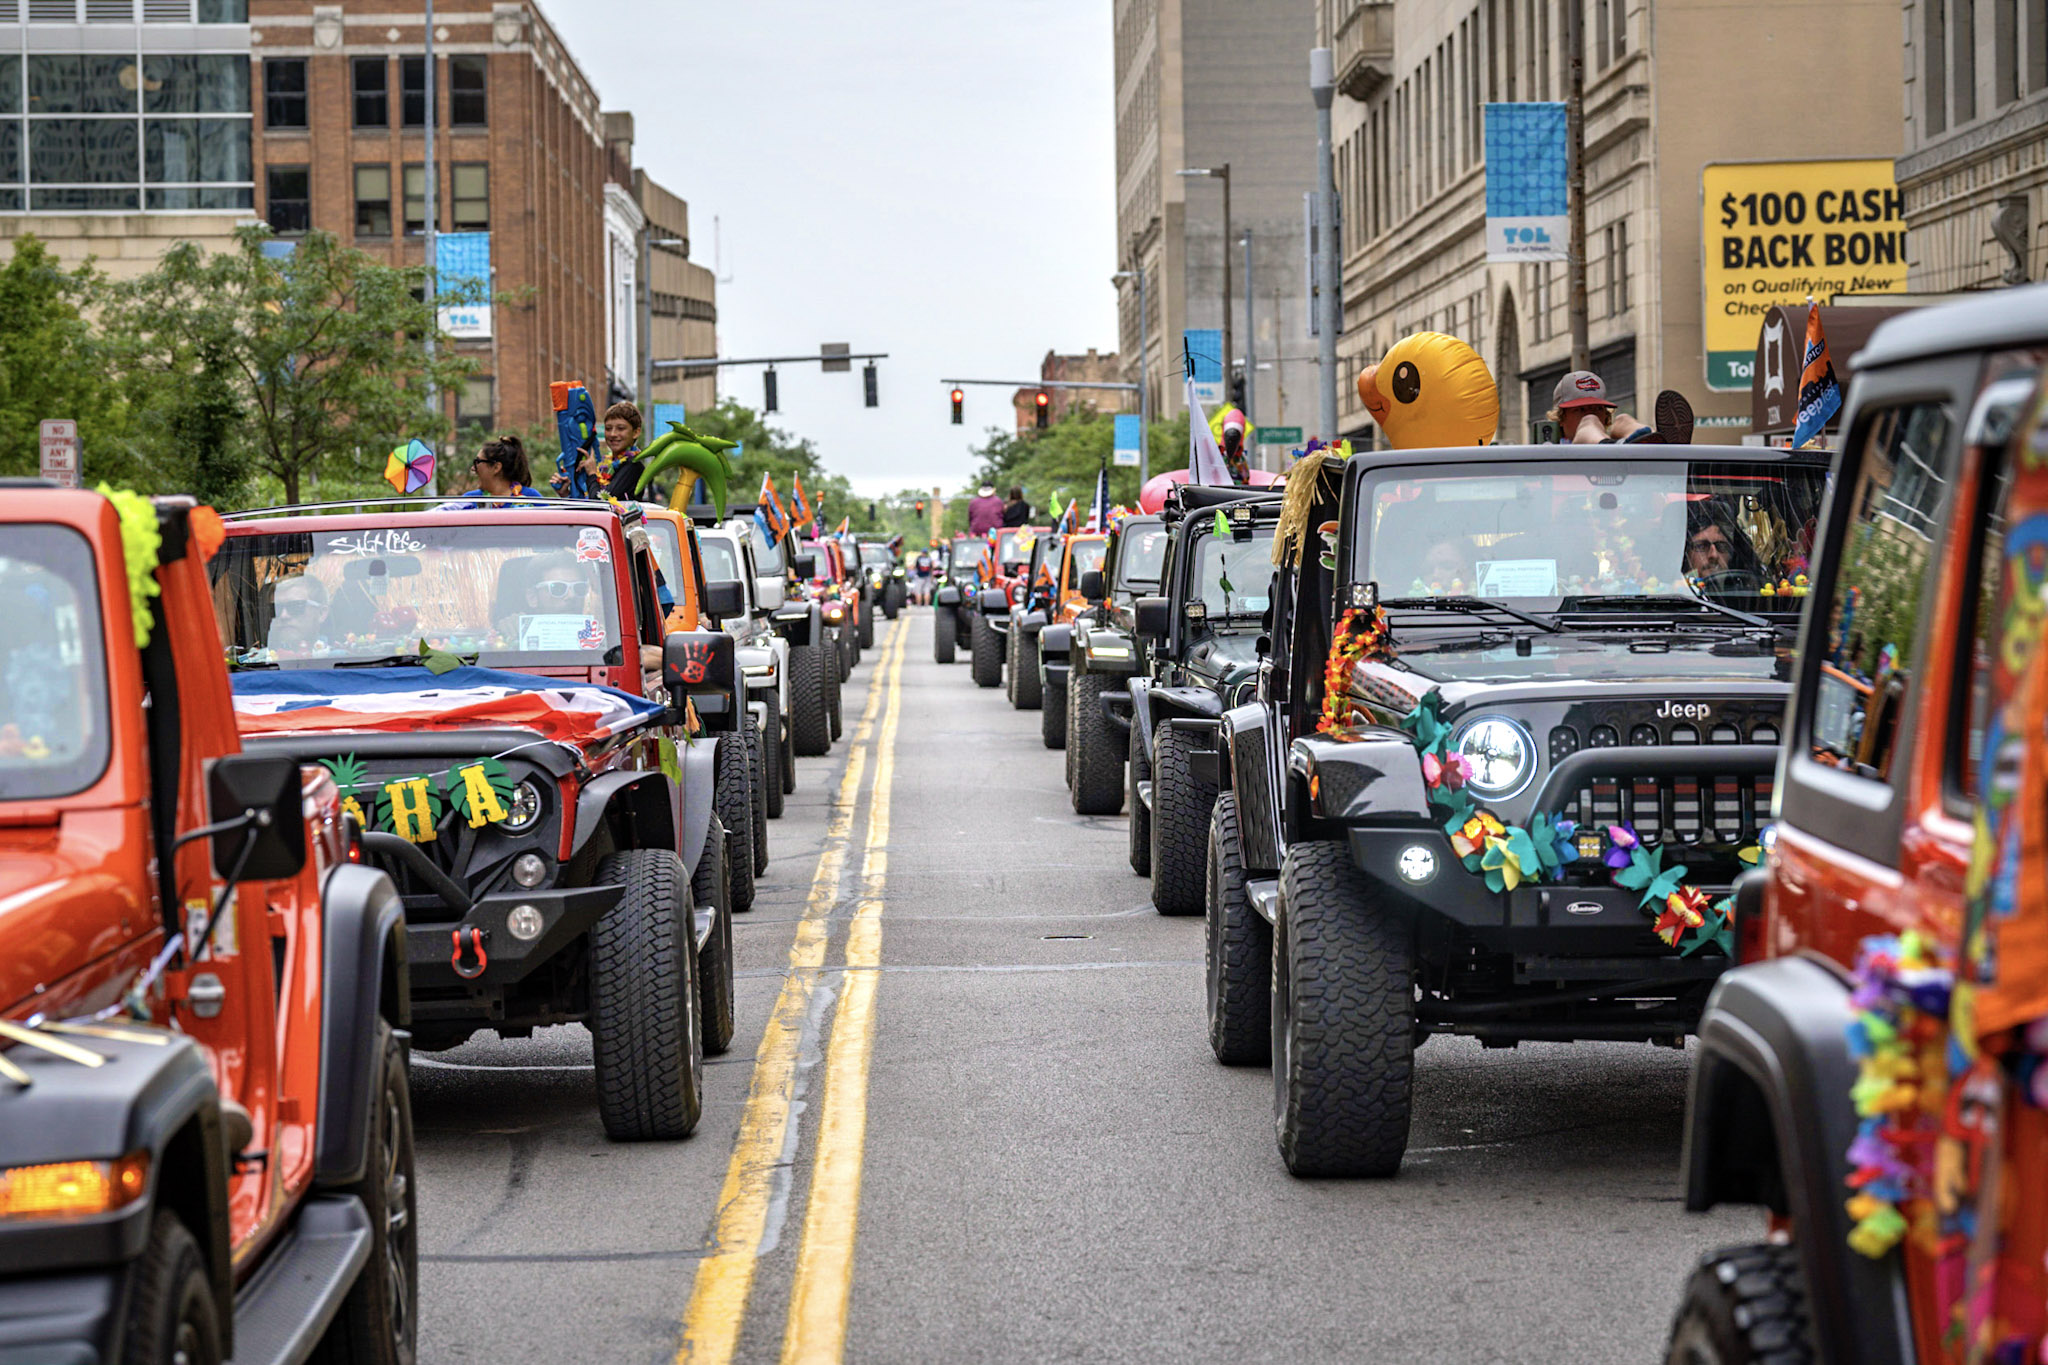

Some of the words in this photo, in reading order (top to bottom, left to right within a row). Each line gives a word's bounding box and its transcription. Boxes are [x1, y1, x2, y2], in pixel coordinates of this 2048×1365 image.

[1721, 191, 1806, 229] $100
[1816, 188, 1905, 223] CASH
[1504, 227, 1551, 244] TOL
[1723, 233, 1815, 269] BACK
[1724, 282, 1746, 294] on
[1752, 276, 1845, 295] Qualifying
[1850, 276, 1894, 292] New
[449, 314, 479, 325] TOL
[1695, 416, 1752, 427] LAMAR
[52, 426, 65, 435] NO
[49, 448, 67, 457] ANY
[49, 459, 68, 468] TIME
[1656, 700, 1711, 721] Jeep
